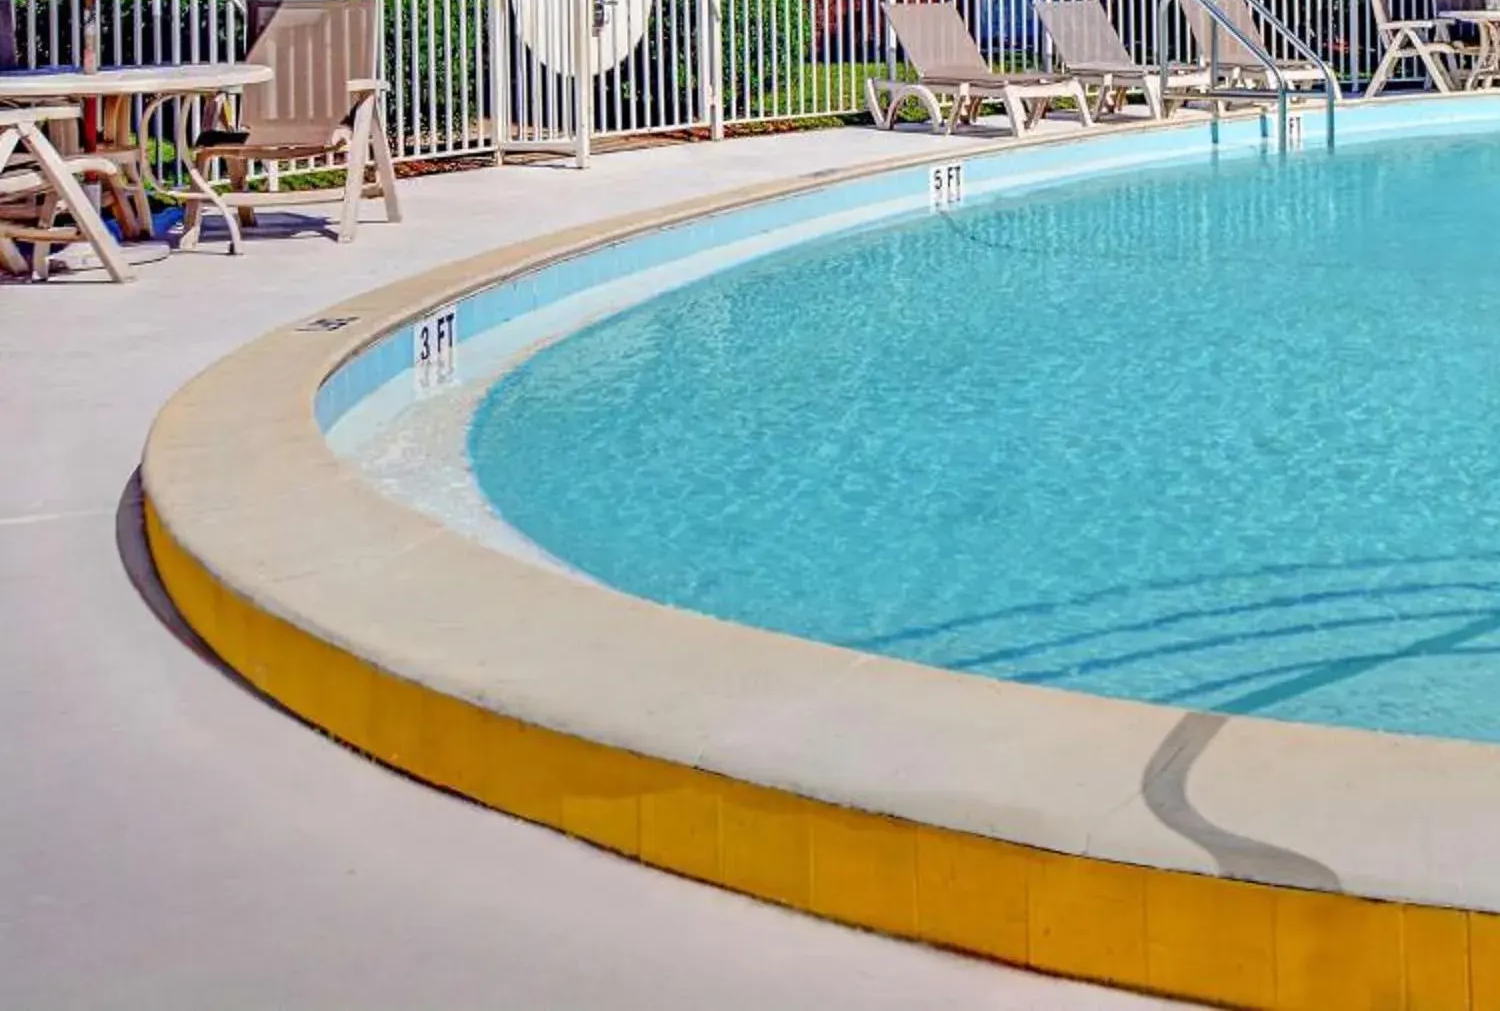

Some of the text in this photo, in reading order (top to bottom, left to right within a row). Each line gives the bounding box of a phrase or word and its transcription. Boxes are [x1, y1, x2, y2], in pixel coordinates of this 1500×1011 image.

[934, 166, 961, 189] 5 FT
[420, 313, 454, 360] 3 FT
